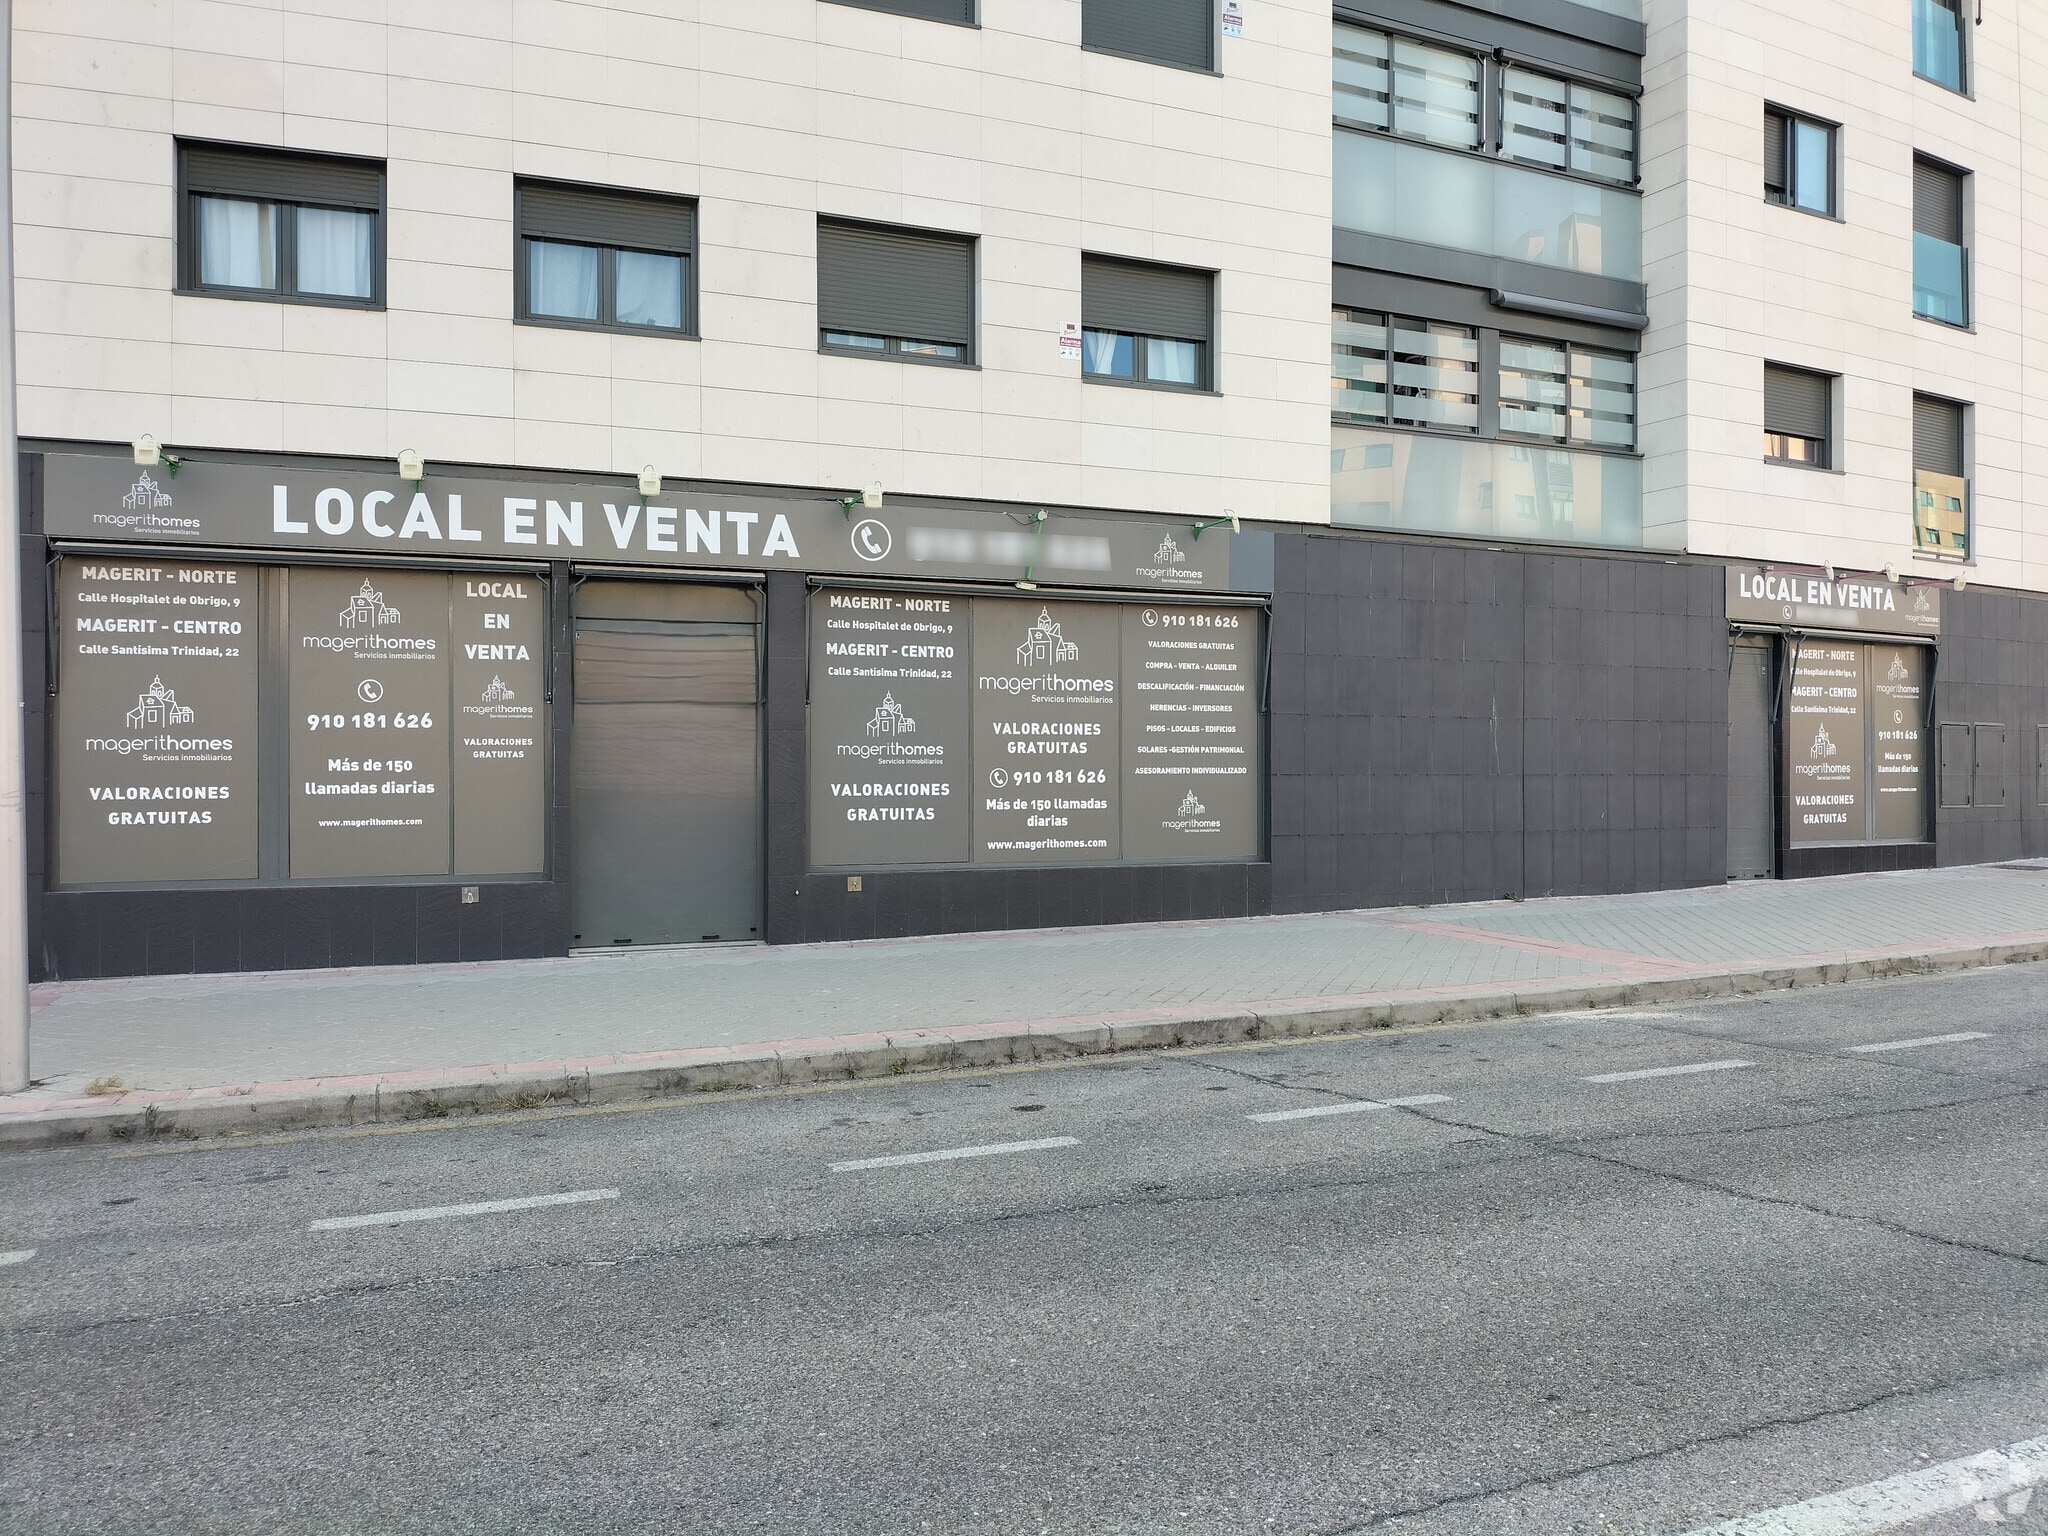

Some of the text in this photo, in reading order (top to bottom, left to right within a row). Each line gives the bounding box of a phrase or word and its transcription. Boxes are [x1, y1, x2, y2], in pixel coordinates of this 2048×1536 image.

[93, 513, 201, 528] magerithomes
[273, 485, 800, 558] LOCAL EN VENTA
[162, 528, 200, 536] inmobiliarios
[82, 566, 162, 582] MAGERIT
[179, 569, 237, 584] NORTE
[1136, 567, 1203, 579] magerithomes
[466, 581, 528, 599] LOCAL
[1740, 573, 1896, 612] LOCAL EN VENTA
[78, 593, 241, 608] Calle Hospitalet de Obrigo, 9
[830, 595, 893, 610] MAGERIT
[905, 598, 951, 613] NORTE
[77, 618, 158, 633] MAGERIT
[173, 620, 242, 635] CENTRO
[484, 613, 510, 629] EN
[827, 619, 953, 634] Calle Hospitalet de Obrigo, 9
[1162, 614, 1239, 628] 910 181 626
[303, 634, 436, 652] magerithomes
[1148, 640, 1235, 650] VALORACIONES GRATUITAS
[79, 644, 240, 658] Calle Santísima Trinidad, 22
[354, 651, 436, 660] Servicios inmobiliarios
[464, 644, 530, 661] VENTA
[826, 642, 889, 657] MAGERIT
[901, 645, 954, 659] CENTRO
[1830, 650, 1855, 661] NORTE
[828, 666, 852, 676] Calle
[899, 668, 940, 679] Trinidad,
[941, 670, 952, 679] 22
[1145, 661, 1173, 669] COMPRA
[1178, 662, 1200, 670] VENTA
[1205, 663, 1237, 671] ALQUILER
[1803, 668, 1829, 677] Hospitalet
[979, 673, 1114, 695] magerithomes
[1137, 682, 1195, 691] DESCALIFICACIÓN
[1199, 683, 1245, 692] FINANCIACIÓN
[1876, 684, 1920, 695] magerithomes
[1791, 686, 1823, 697] MAGERIT
[1828, 687, 1857, 698] CENTRO
[1031, 694, 1113, 704] Servicios inmobiliarios
[463, 704, 533, 715] magerithomes
[1149, 704, 1187, 712] HERENCIAS
[1192, 704, 1233, 712] INVERSORES
[1791, 705, 1804, 713] Calle
[307, 712, 433, 731] 910 181 626
[993, 722, 1101, 736] VALORACIONES
[1171, 725, 1200, 733] LOCALES
[1205, 725, 1236, 733] EDIFICIOS
[1878, 730, 1918, 741] 910 181 626
[86, 735, 233, 755] magerithomes
[464, 738, 533, 746] VALORACIONES
[1007, 741, 1088, 754] GRATUITAS
[473, 750, 525, 758] GRATUITAS
[837, 742, 944, 759] magerithomes
[1200, 746, 1245, 754] PATRIMONIAL
[1884, 752, 1912, 761] Más de 150
[328, 758, 413, 773] Más de 150
[1134, 767, 1247, 775] ASESORAMIENTO INDIVIDUALIZADO
[1795, 762, 1851, 777] magerithomes
[1901, 764, 1919, 773] diarias
[1013, 769, 1106, 786] 910 181 626
[89, 786, 230, 801] VALORACIONES
[305, 781, 435, 795] llamadas diarias
[831, 783, 950, 797] VALORACIONES
[986, 798, 1108, 811] Más de 150 llamadas
[1795, 794, 1854, 806] VALORACIONES
[108, 811, 213, 825] GRATUITAS
[847, 807, 935, 821] GRATUITAS
[1803, 813, 1847, 824] GRATUITAS
[318, 818, 423, 828] www.magerithomes.com
[1027, 815, 1068, 827] diarias
[1162, 819, 1221, 830] magerithomes
[987, 839, 1107, 850] www.magerithomes.com
